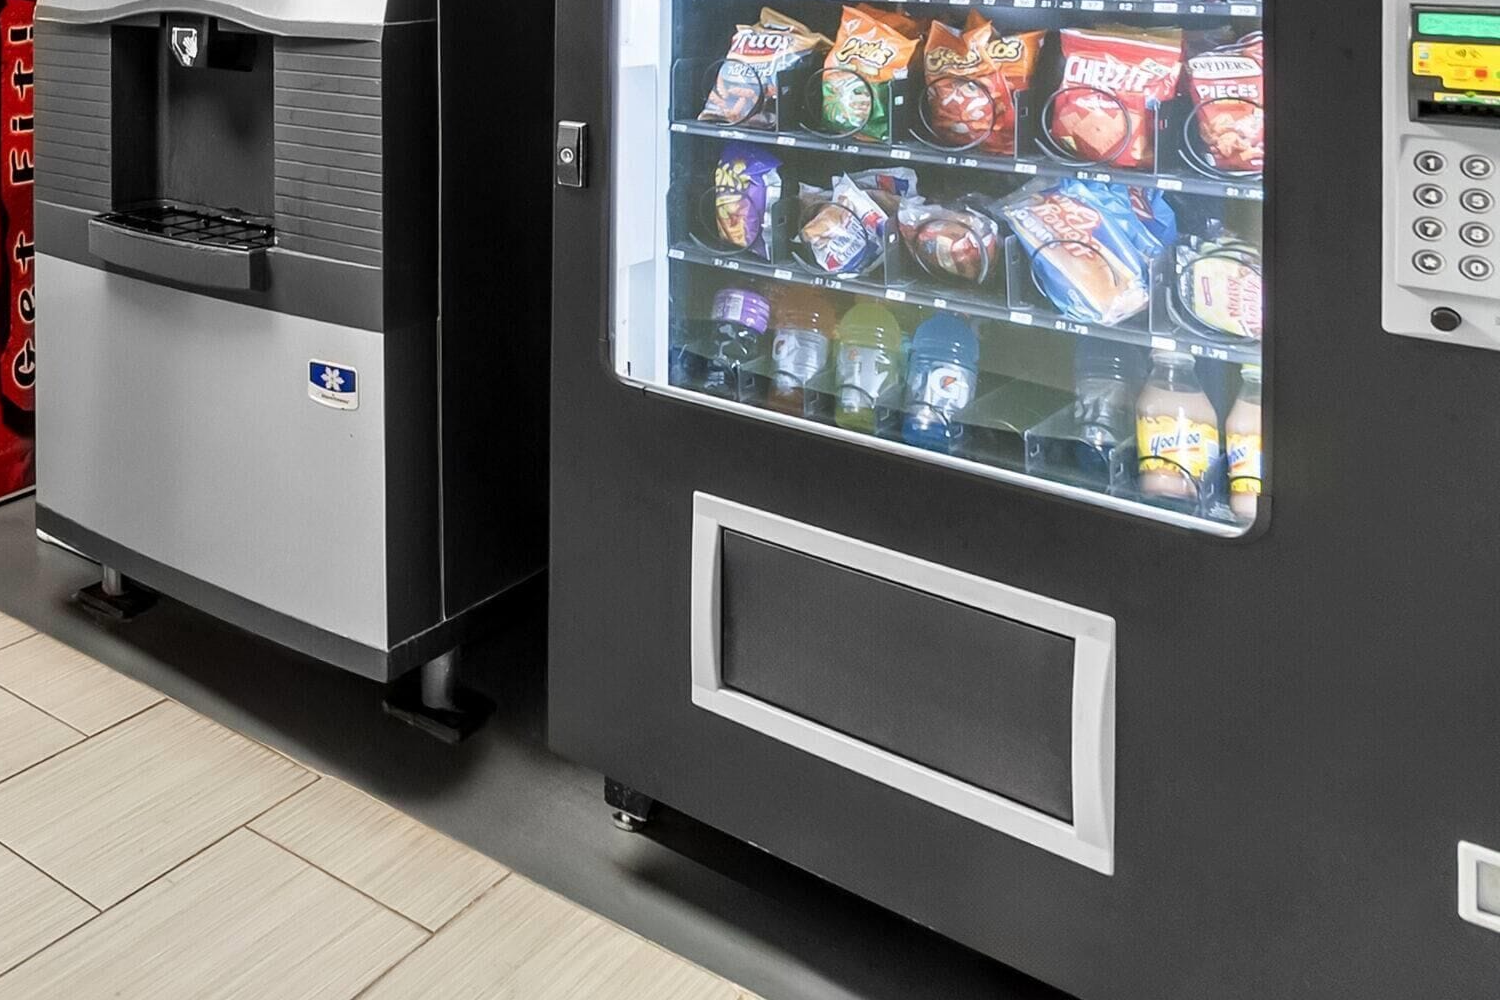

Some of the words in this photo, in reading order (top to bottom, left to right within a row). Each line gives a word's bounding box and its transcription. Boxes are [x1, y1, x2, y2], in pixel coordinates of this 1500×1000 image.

[1195, 83, 1258, 99] PIECES
[1426, 157, 1436, 170] 1
[1471, 161, 1485, 174] 2
[1425, 190, 1438, 202] 4
[1471, 195, 1485, 208] 5
[1424, 222, 1437, 235] 7
[1470, 229, 1484, 241] 8
